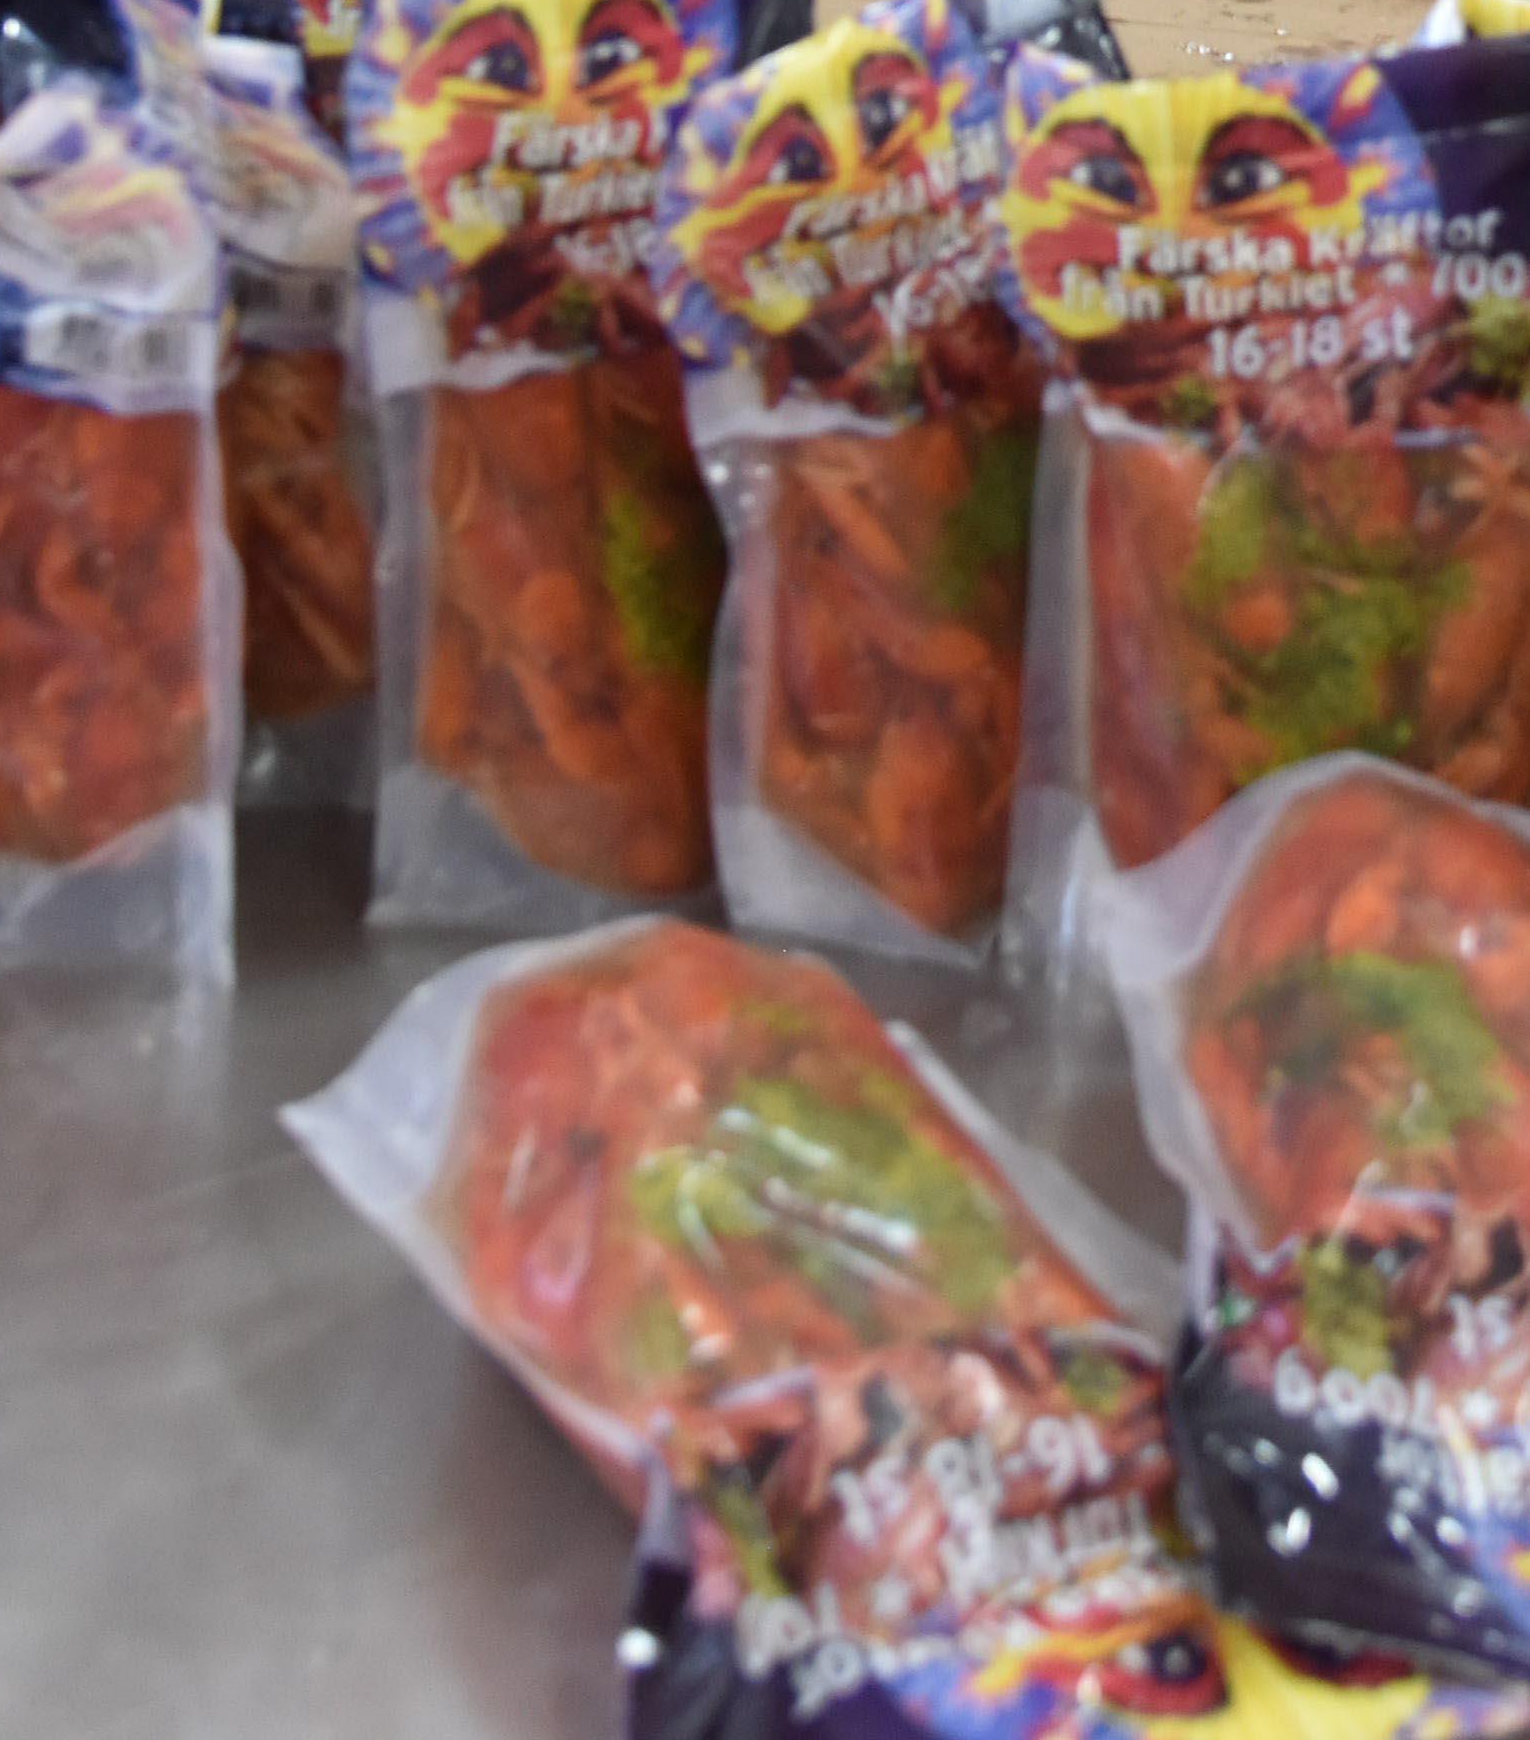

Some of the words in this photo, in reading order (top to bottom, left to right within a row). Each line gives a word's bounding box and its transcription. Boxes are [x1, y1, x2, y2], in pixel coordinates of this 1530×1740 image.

[1116, 223, 1296, 275] Färska
[1183, 265, 1356, 319] Turkiet
[1207, 316, 1343, 379] 16-18
[1362, 308, 1414, 360] st
